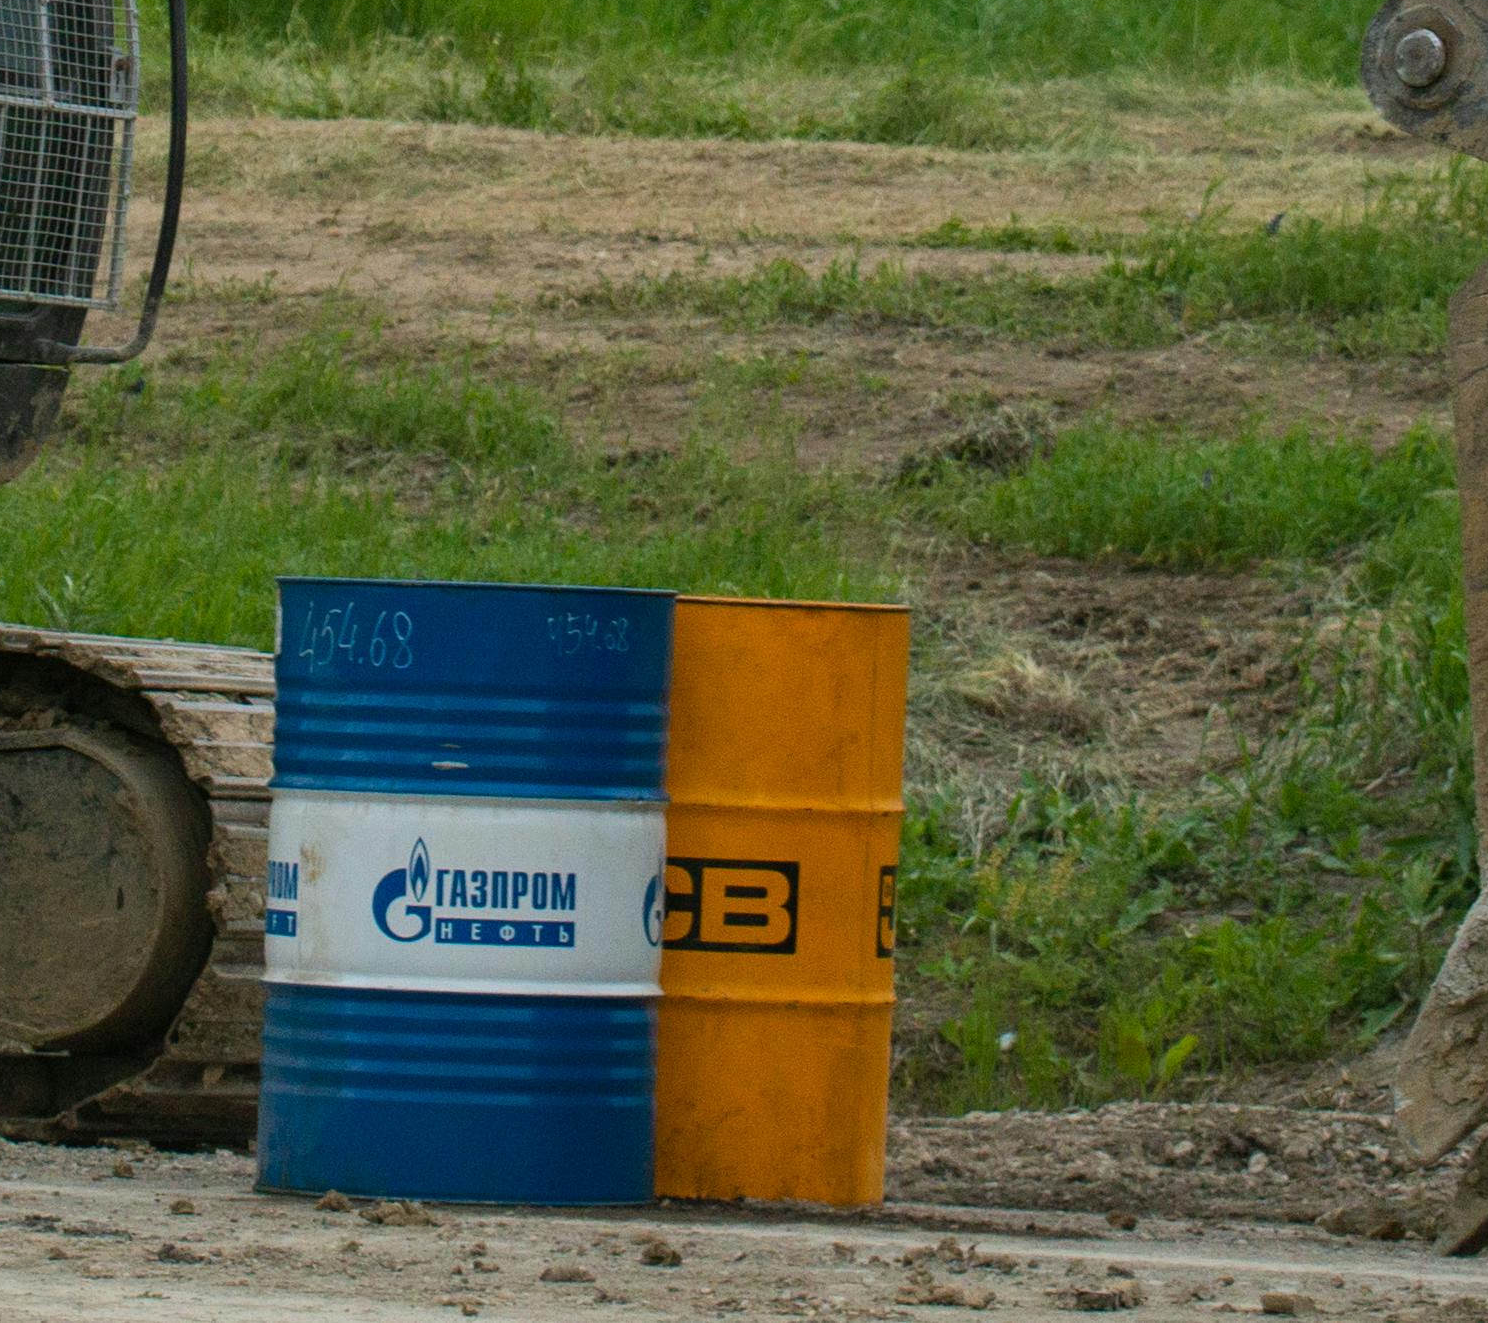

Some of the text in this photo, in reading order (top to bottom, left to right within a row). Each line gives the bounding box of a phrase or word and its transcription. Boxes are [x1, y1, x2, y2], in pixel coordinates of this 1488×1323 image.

[298, 601, 413, 673] 454.68
[435, 868, 576, 911] ГАЗПРОМ
[439, 921, 570, 944] НЕФТЬ
